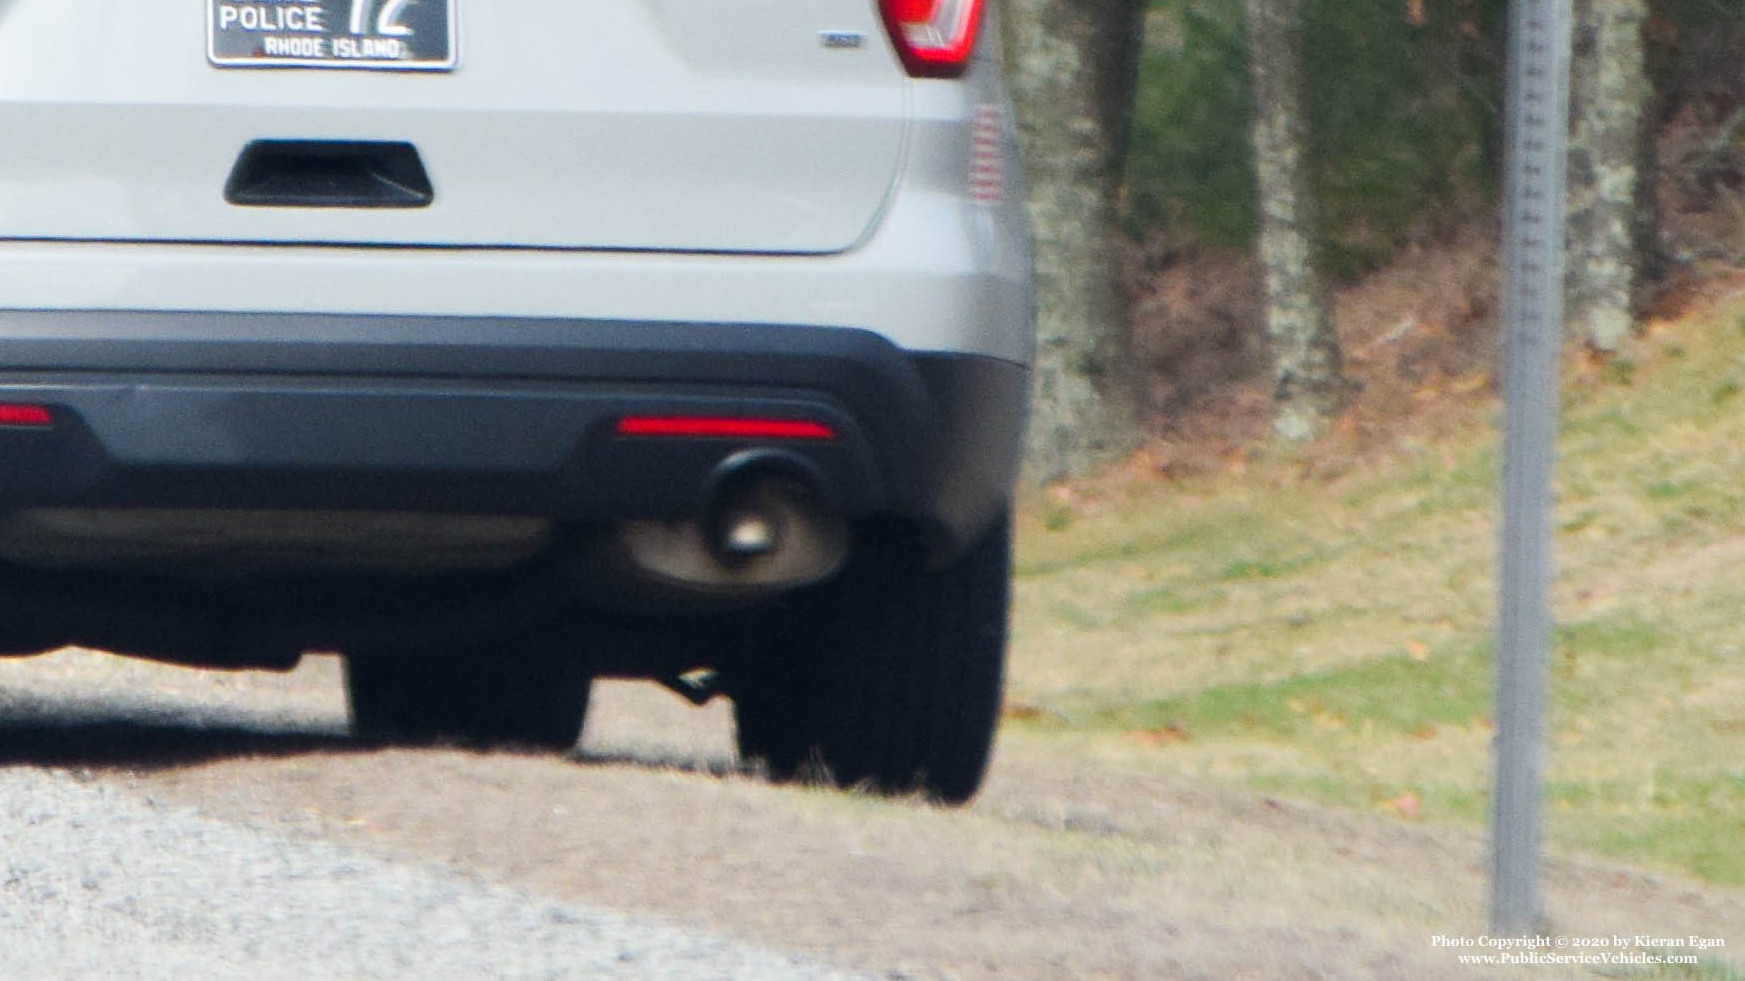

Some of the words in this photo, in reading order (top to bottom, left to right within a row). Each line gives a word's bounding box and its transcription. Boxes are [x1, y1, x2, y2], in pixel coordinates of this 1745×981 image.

[220, 6, 324, 31] POLICE
[264, 37, 325, 55] RHODE
[332, 38, 400, 58] ISLAND
